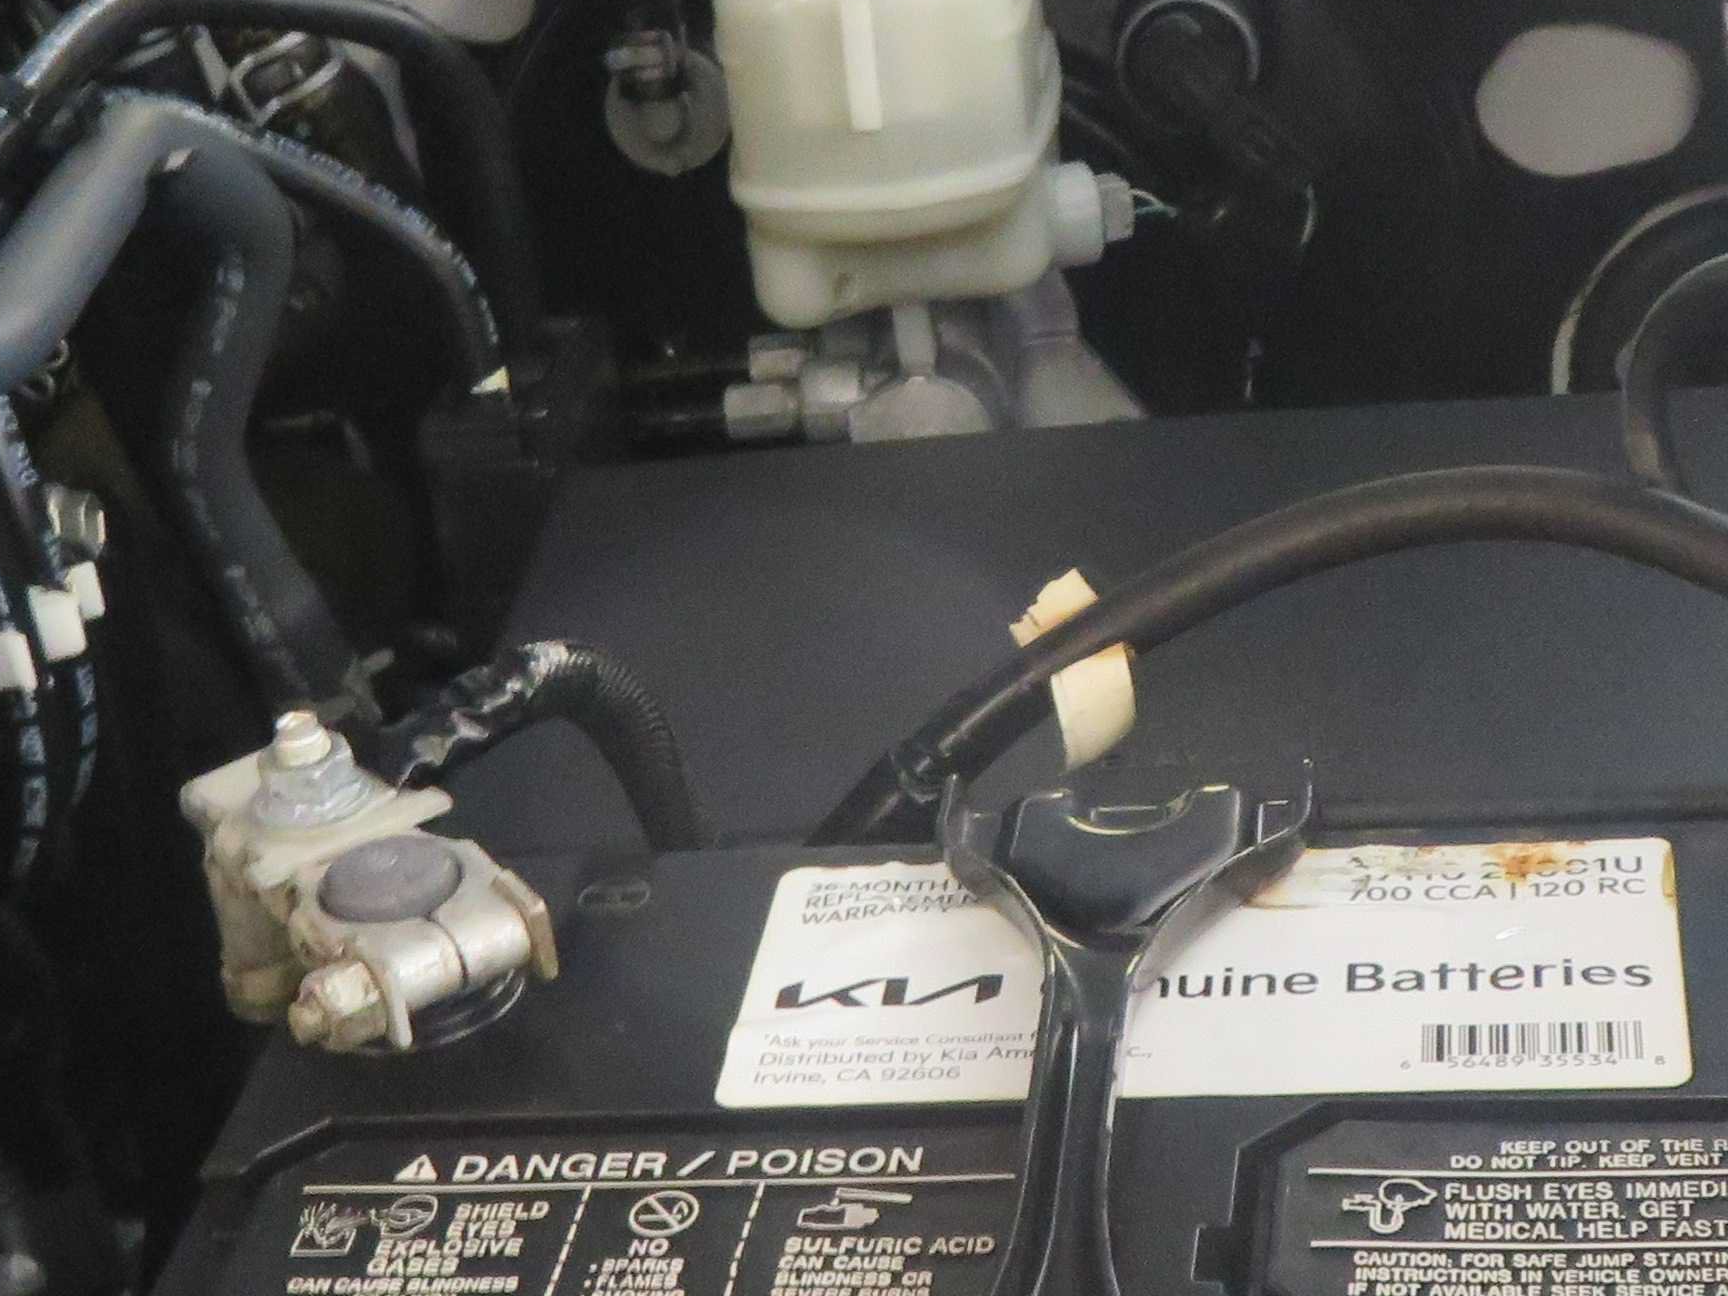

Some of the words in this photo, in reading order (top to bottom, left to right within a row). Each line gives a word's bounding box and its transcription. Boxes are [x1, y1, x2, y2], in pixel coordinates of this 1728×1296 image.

[1349, 875, 1412, 901] 700
[1424, 884, 1497, 901] CCA
[1531, 878, 1585, 898] 120
[1599, 877, 1647, 895] RC
[775, 974, 1005, 1010] KIA
[1345, 959, 1654, 994] Batteries
[855, 1035, 921, 1047] Service
[759, 1051, 896, 1067] Distributed
[903, 1049, 934, 1067] by
[940, 1048, 978, 1063] Kia
[753, 1070, 826, 1086] Irvine,
[836, 1068, 872, 1083] CA
[881, 1065, 961, 1081] 92606
[1500, 1140, 1556, 1155] KEEP
[1564, 1139, 1612, 1155] OUT
[1620, 1139, 1652, 1154] OF
[1661, 1138, 1710, 1153] THE
[452, 1151, 668, 1183] DANGER
[726, 1146, 925, 1176] POISON
[1450, 1155, 1483, 1170] DO
[1490, 1155, 1537, 1170] NOT
[1547, 1154, 1588, 1170] TIP.
[1598, 1154, 1658, 1169] KEEP
[1664, 1153, 1724, 1168] VENT
[1444, 1183, 1533, 1201] FLUSH
[1543, 1182, 1614, 1201] EYES
[453, 1200, 550, 1221] SHIELD
[1444, 1202, 1514, 1221] WITH
[1526, 1202, 1627, 1220] WATER.
[1639, 1199, 1695, 1219] GET
[445, 1220, 517, 1239] EYES
[1444, 1221, 1565, 1241] MEDICAL
[1576, 1220, 1649, 1240] HELP
[375, 1238, 524, 1259] EXPLOSIVE
[627, 1239, 672, 1258] NO
[783, 1236, 923, 1255] SULFURIC
[928, 1236, 996, 1255] ACID
[366, 1257, 461, 1278] GASES
[778, 1255, 824, 1272] CAN
[832, 1255, 906, 1272] CAUSE
[1460, 1251, 1505, 1268] FOR
[1512, 1251, 1568, 1268] SAFE
[1575, 1251, 1635, 1268] JUMP
[334, 1276, 403, 1294] CAUSE
[406, 1274, 520, 1293] BLINDNESS
[596, 1274, 679, 1290] FLAMES
[774, 1271, 893, 1288] BLINDNESS
[899, 1271, 934, 1288] OR
[1354, 1267, 1513, 1284] INSTRUCTIONS
[1521, 1267, 1543, 1284] IN
[1551, 1267, 1641, 1284] VEHICLE
